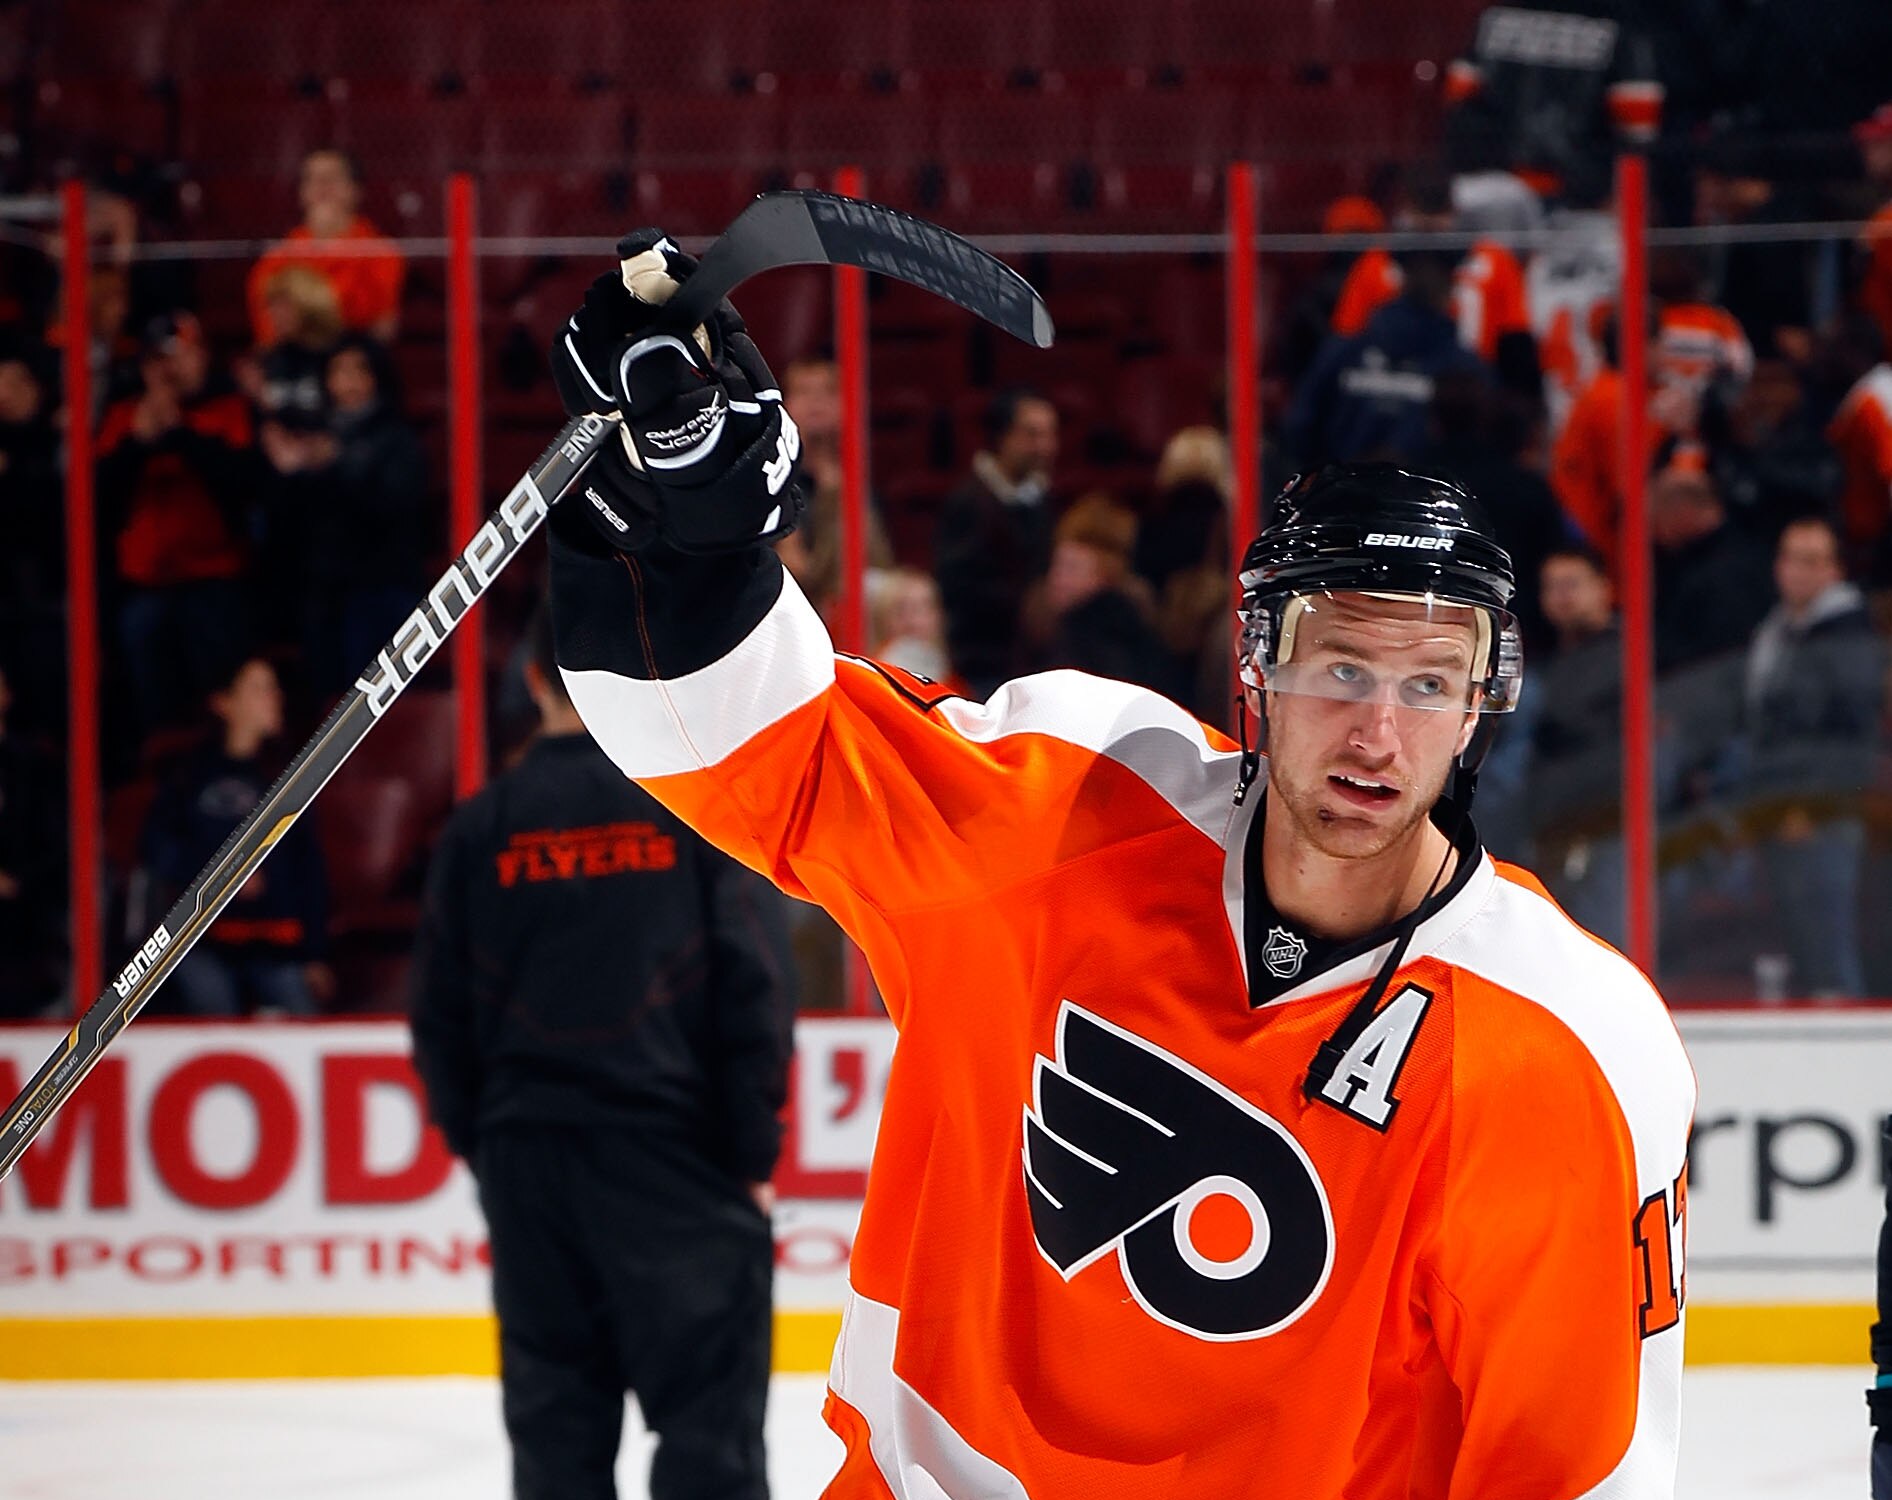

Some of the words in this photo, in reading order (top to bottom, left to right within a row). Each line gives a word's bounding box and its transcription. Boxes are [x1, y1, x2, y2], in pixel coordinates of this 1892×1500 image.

[560, 415, 604, 464] ONE
[584, 486, 631, 534] BAUER
[1363, 533, 1455, 552] BAUER
[355, 472, 549, 718] BAUER
[112, 923, 172, 998] BAUER
[1268, 946, 1298, 961] NHL
[1318, 981, 1434, 1133] A
[13, 1110, 35, 1135] ONE
[33, 1084, 57, 1113] TOTAL
